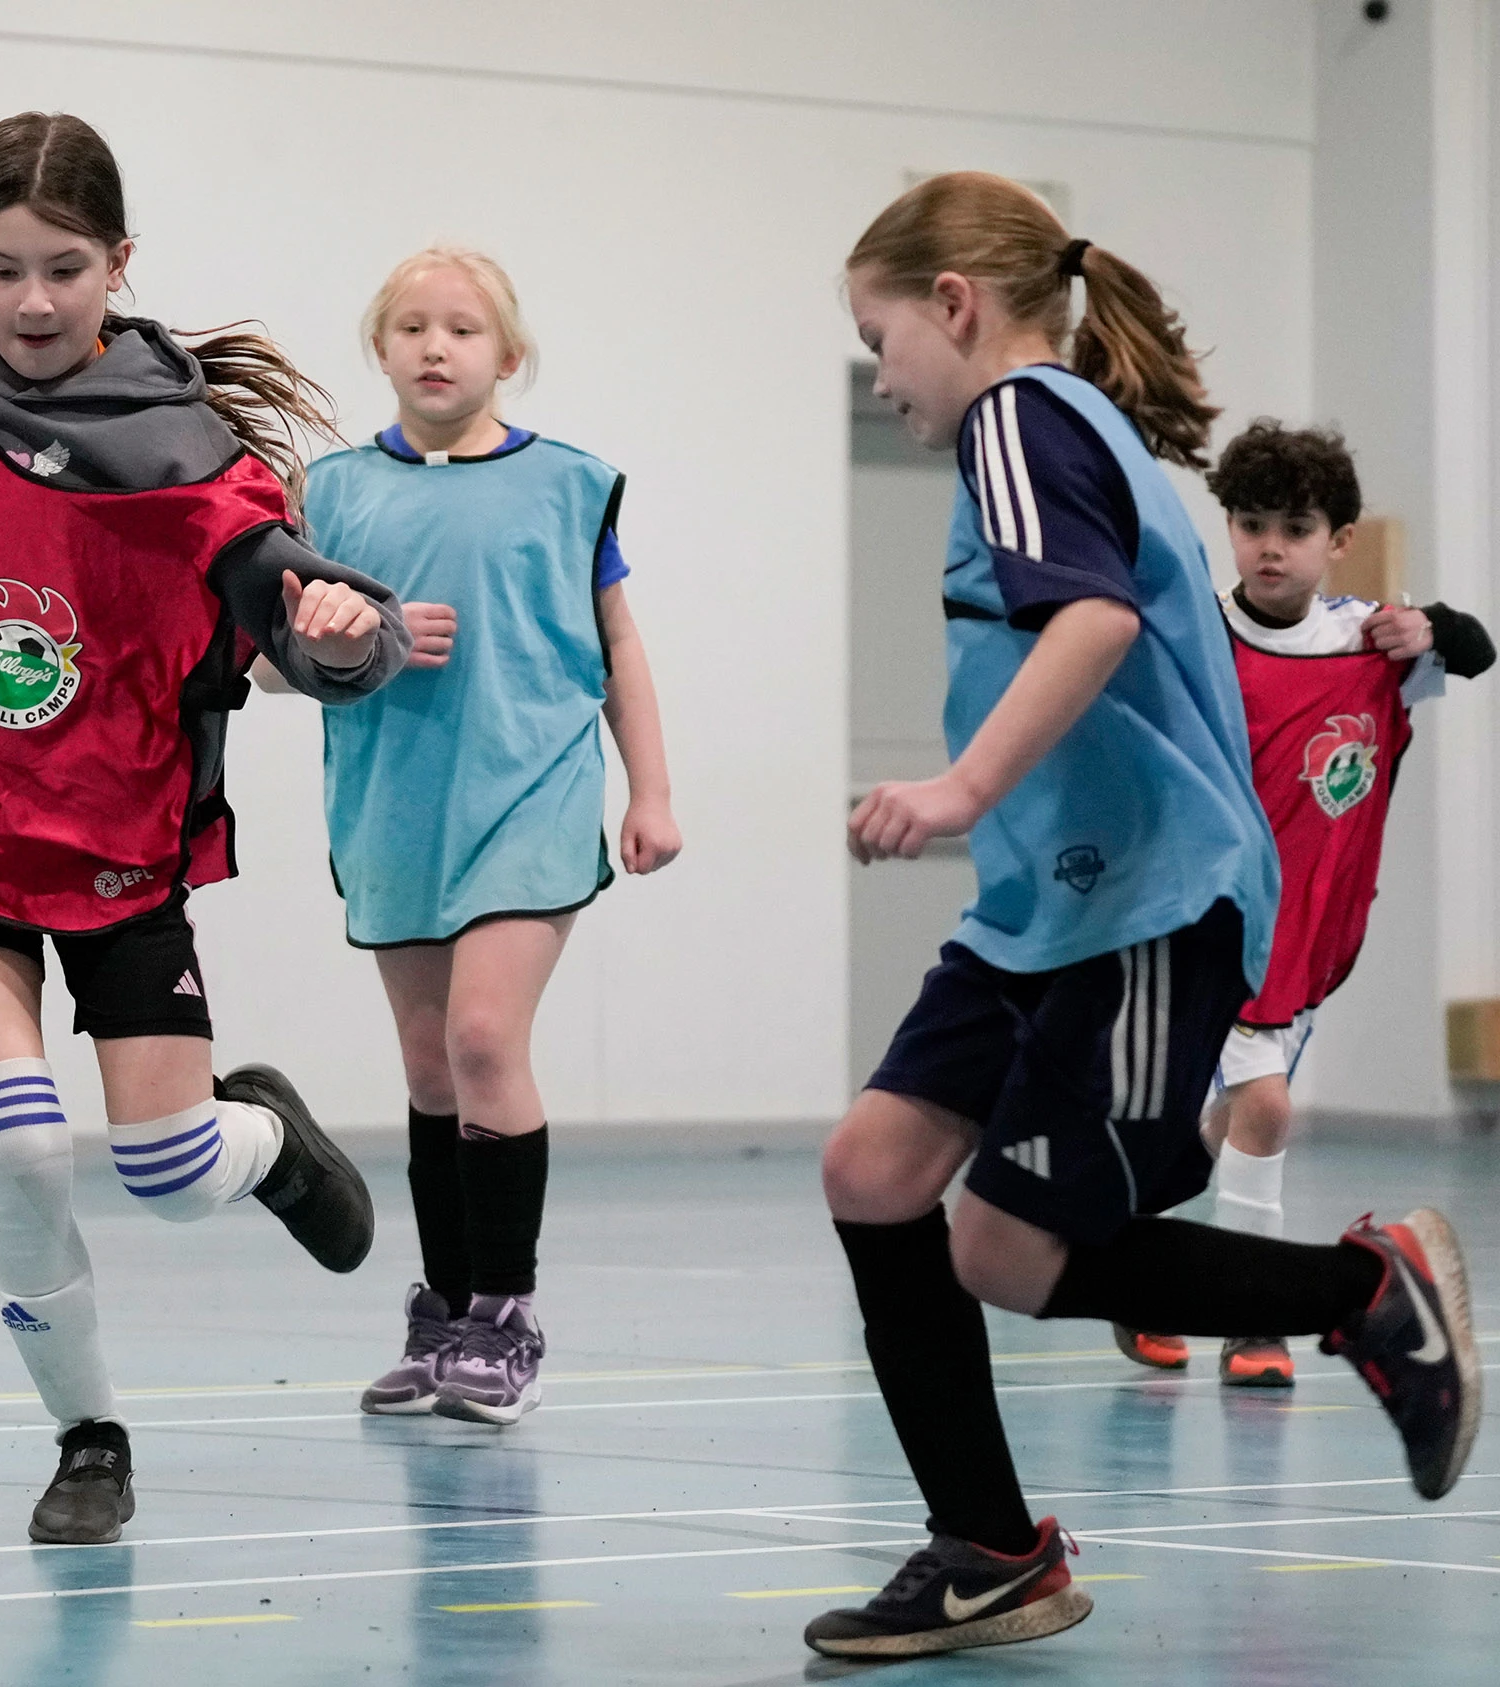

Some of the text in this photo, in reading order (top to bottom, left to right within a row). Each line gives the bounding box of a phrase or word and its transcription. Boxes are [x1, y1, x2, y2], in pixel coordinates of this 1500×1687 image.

[25, 676, 76, 724] CAMPS
[120, 868, 155, 887] EFL
[3, 1317, 52, 1333] didas
[68, 1447, 118, 1473] NIKE
